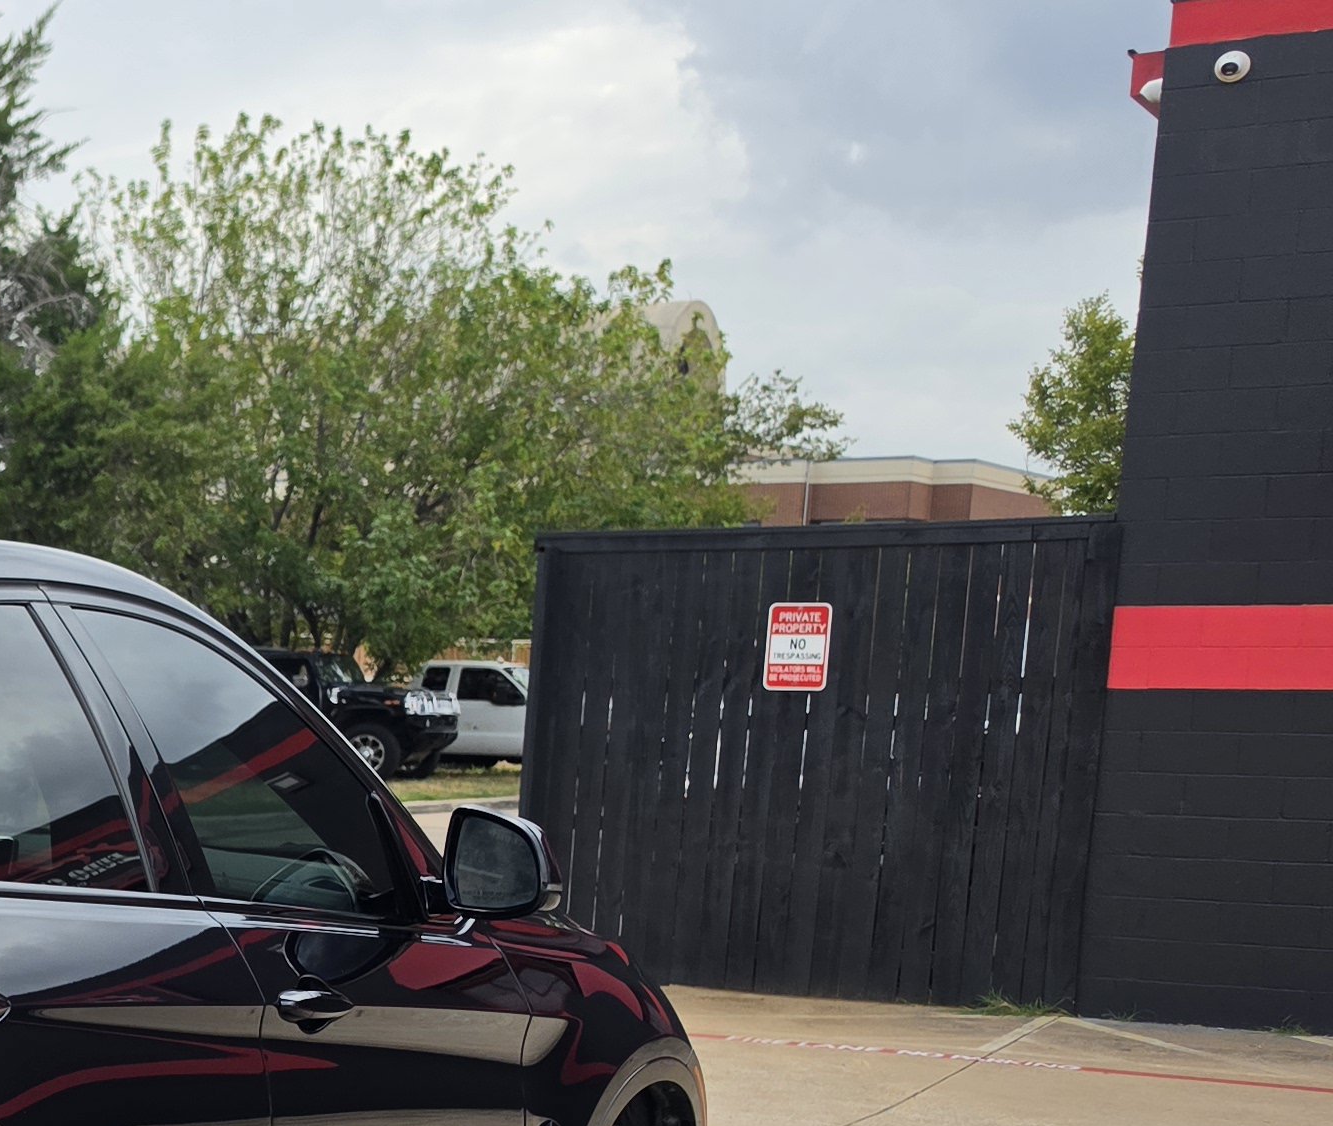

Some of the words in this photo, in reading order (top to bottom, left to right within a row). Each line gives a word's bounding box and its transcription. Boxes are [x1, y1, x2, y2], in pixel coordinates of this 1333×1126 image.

[778, 612, 822, 622] PRIVATE
[772, 623, 826, 633] PROPERTY
[790, 638, 806, 650] NO
[773, 652, 822, 661] TRESPASSING
[896, 1049, 945, 1058] NO
[950, 1055, 1082, 1070] PARKING
